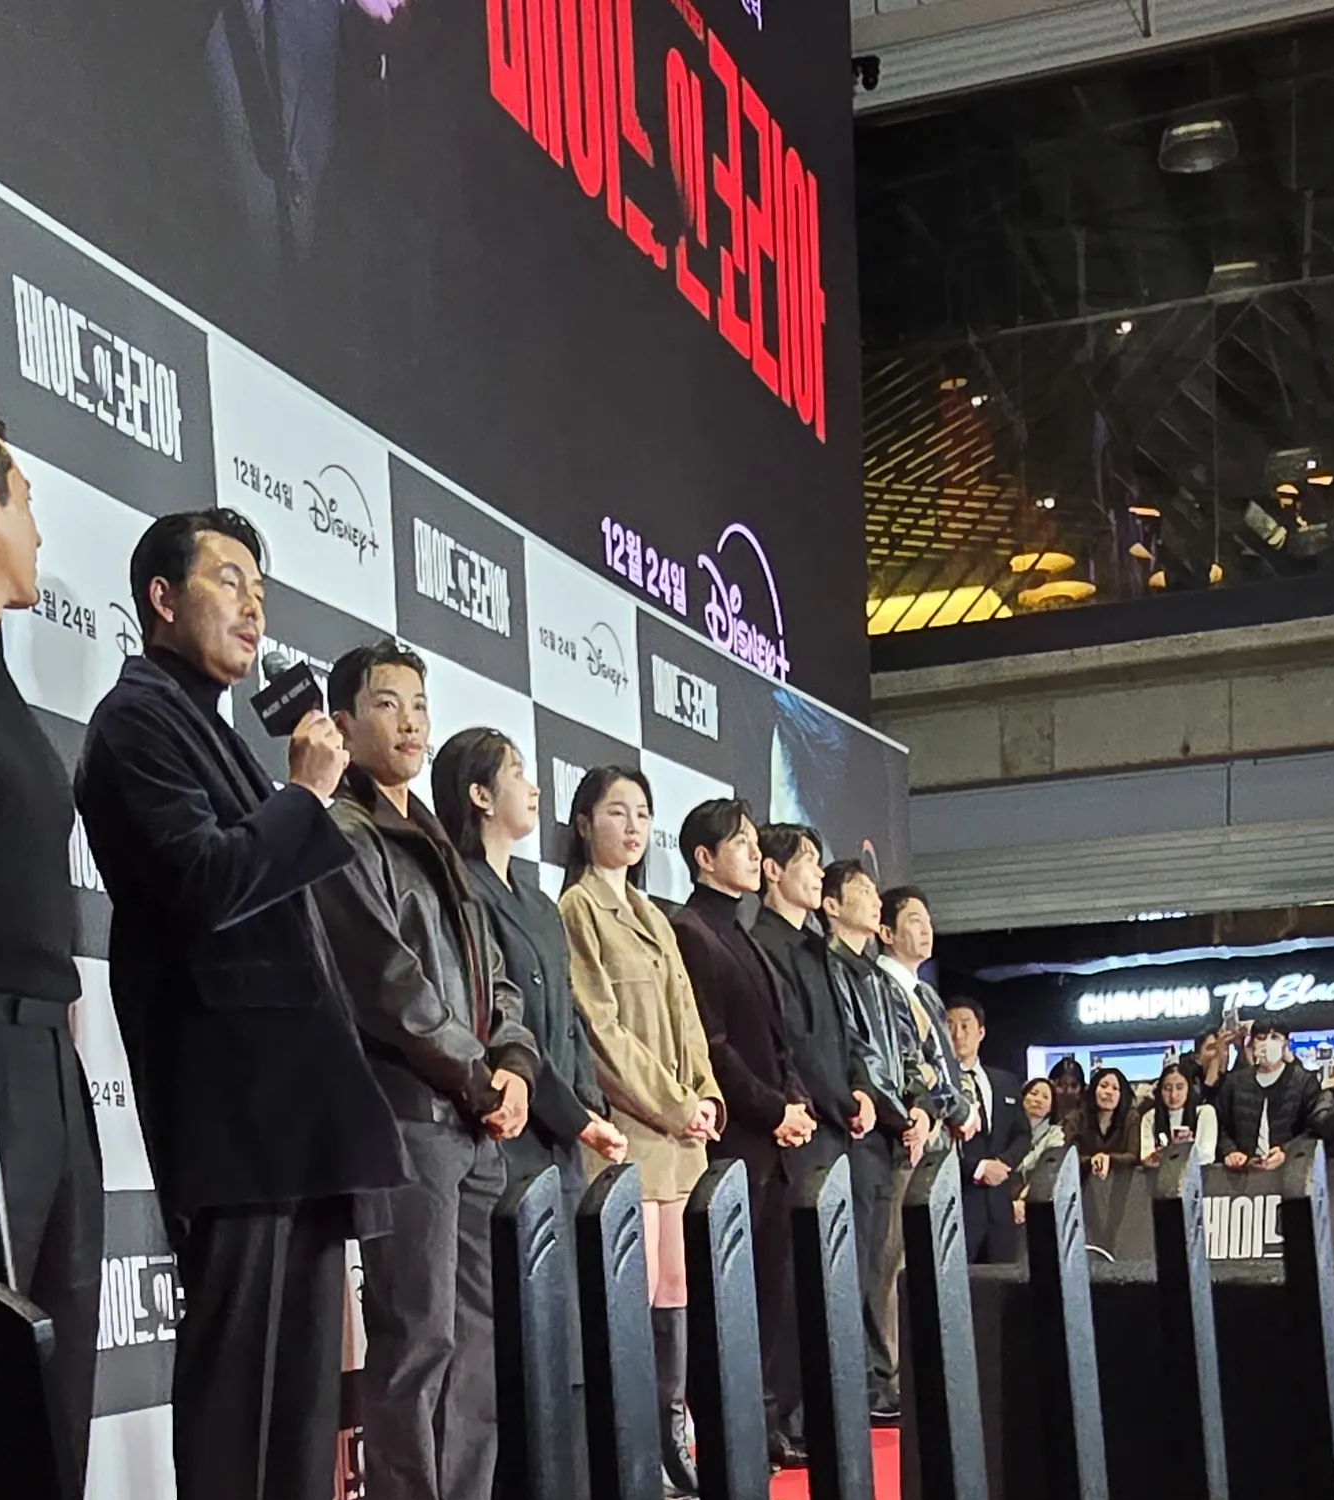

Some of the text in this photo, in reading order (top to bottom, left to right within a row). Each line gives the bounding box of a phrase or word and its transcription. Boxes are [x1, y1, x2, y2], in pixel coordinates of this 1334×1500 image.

[708, 27, 825, 443] 코리아
[12, 274, 95, 413] 메이드
[113, 335, 182, 463] 코리아
[233, 456, 379, 566] 12월 24일 Disney+
[62, 600, 97, 640] 24일
[414, 517, 460, 611] 메이드
[469, 550, 510, 637] 코리아
[601, 516, 790, 683] 12월 24일 Disney+
[558, 636, 577, 661] 24일
[1078, 985, 1210, 1025] CHAMPION
[90, 1080, 126, 1108] 24일
